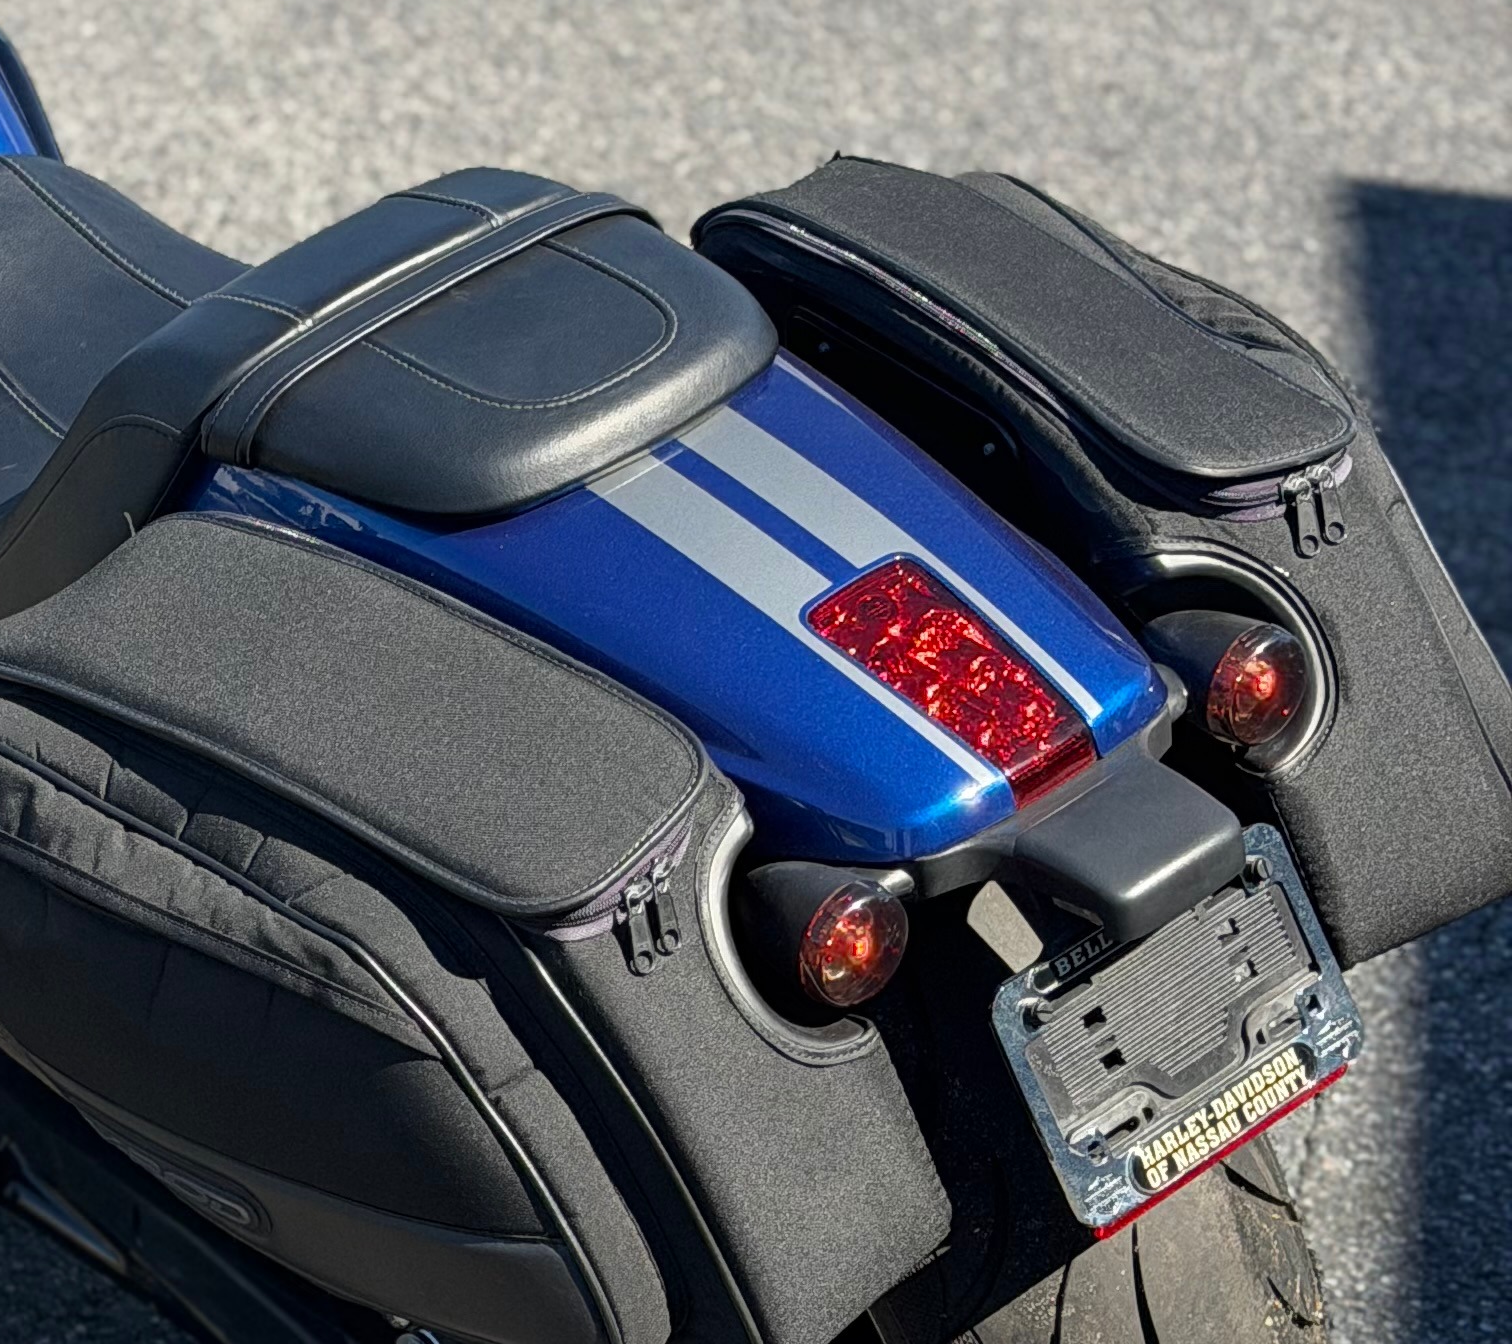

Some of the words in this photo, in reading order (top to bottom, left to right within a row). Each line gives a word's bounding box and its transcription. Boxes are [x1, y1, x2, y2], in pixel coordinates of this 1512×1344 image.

[1140, 1047, 1300, 1170] HARLEY-DAVIDSON
[1146, 1159, 1169, 1189] OF
[1172, 1112, 1242, 1172] NASSAU
[1242, 1064, 1308, 1124] COUNTY
